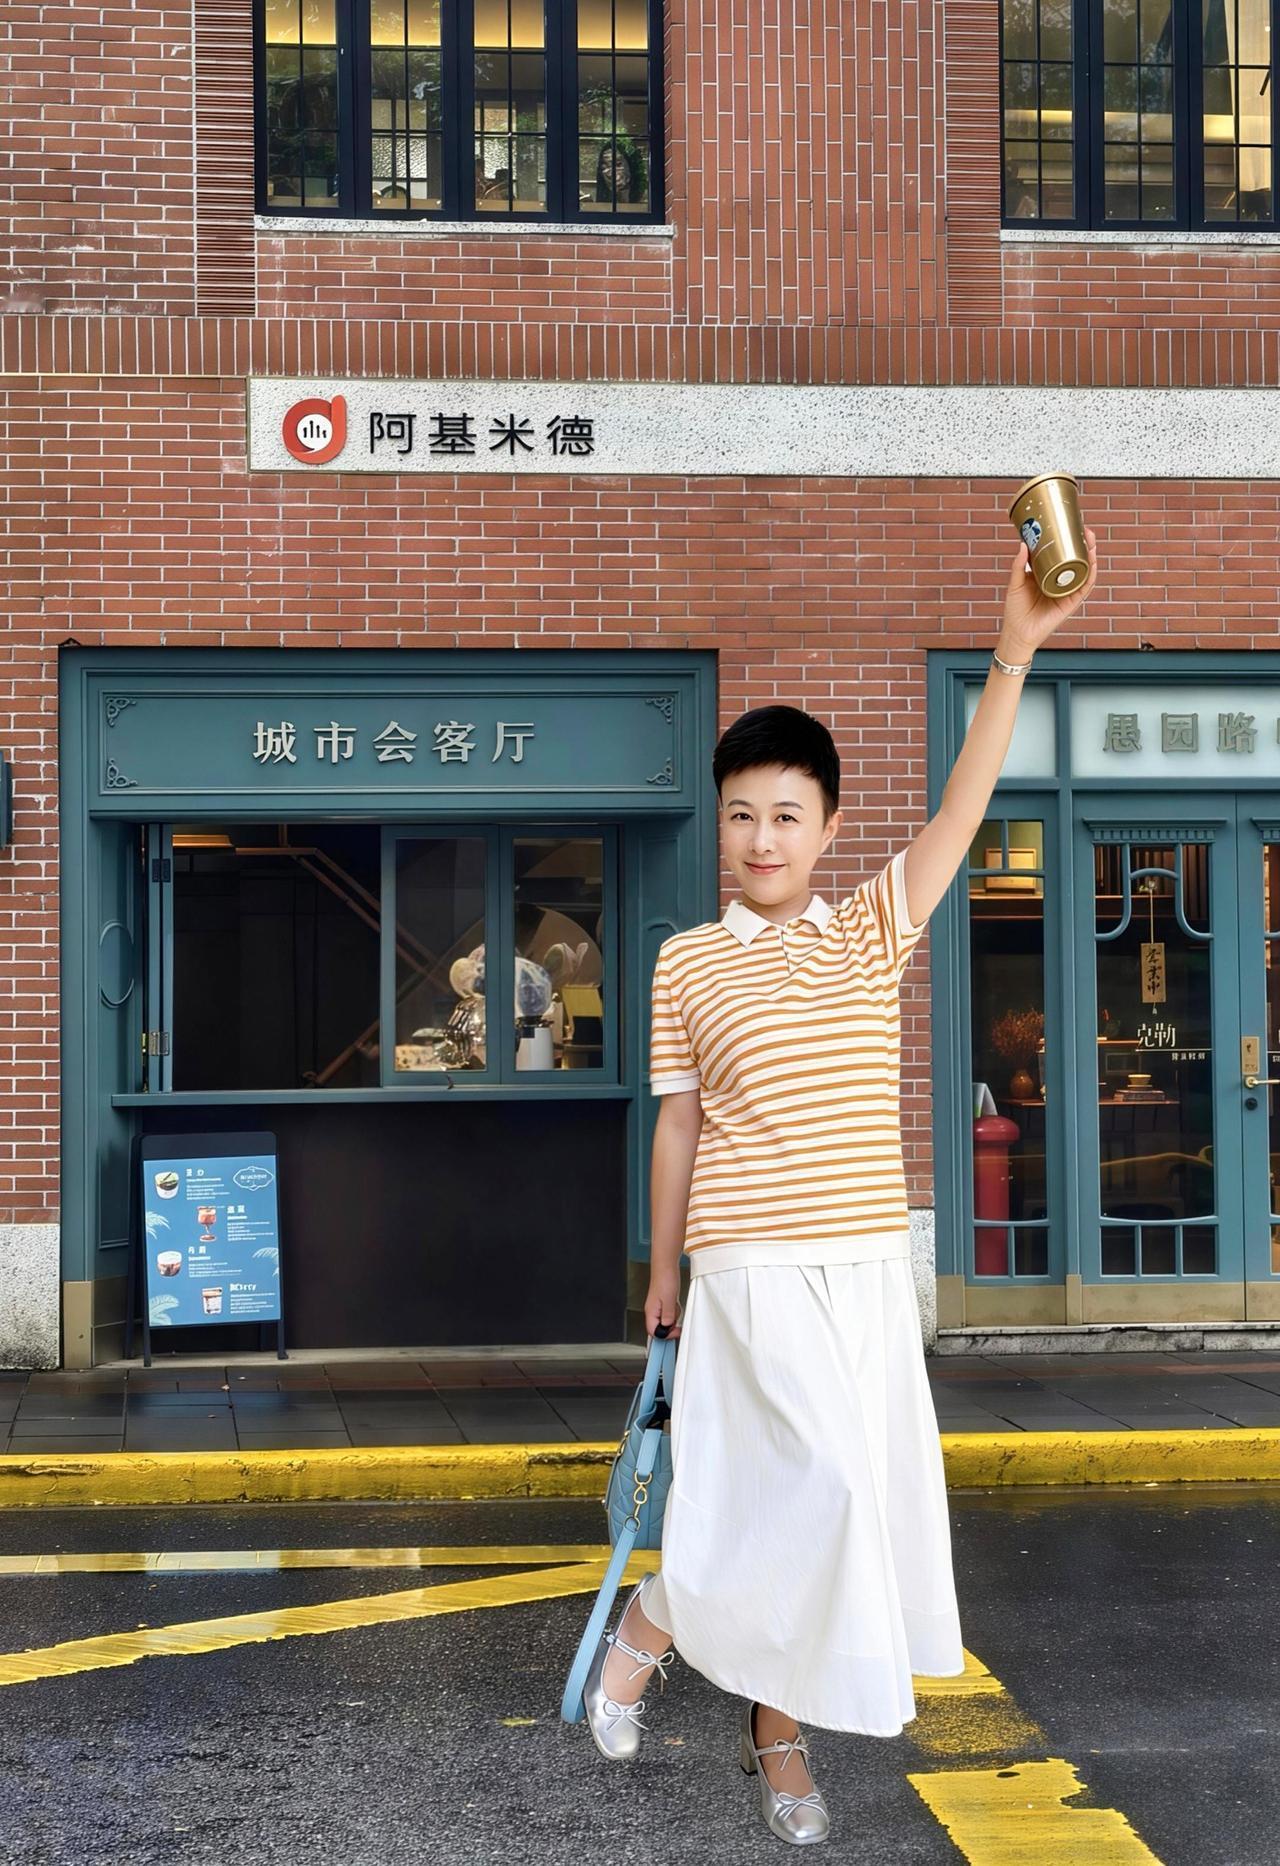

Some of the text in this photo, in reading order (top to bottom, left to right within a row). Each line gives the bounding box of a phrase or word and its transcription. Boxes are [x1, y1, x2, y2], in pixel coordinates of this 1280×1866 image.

[369, 412, 595, 455] 阿基米德
[253, 721, 535, 764] 城市会客厅
[1103, 712, 1280, 753] 愚园路
